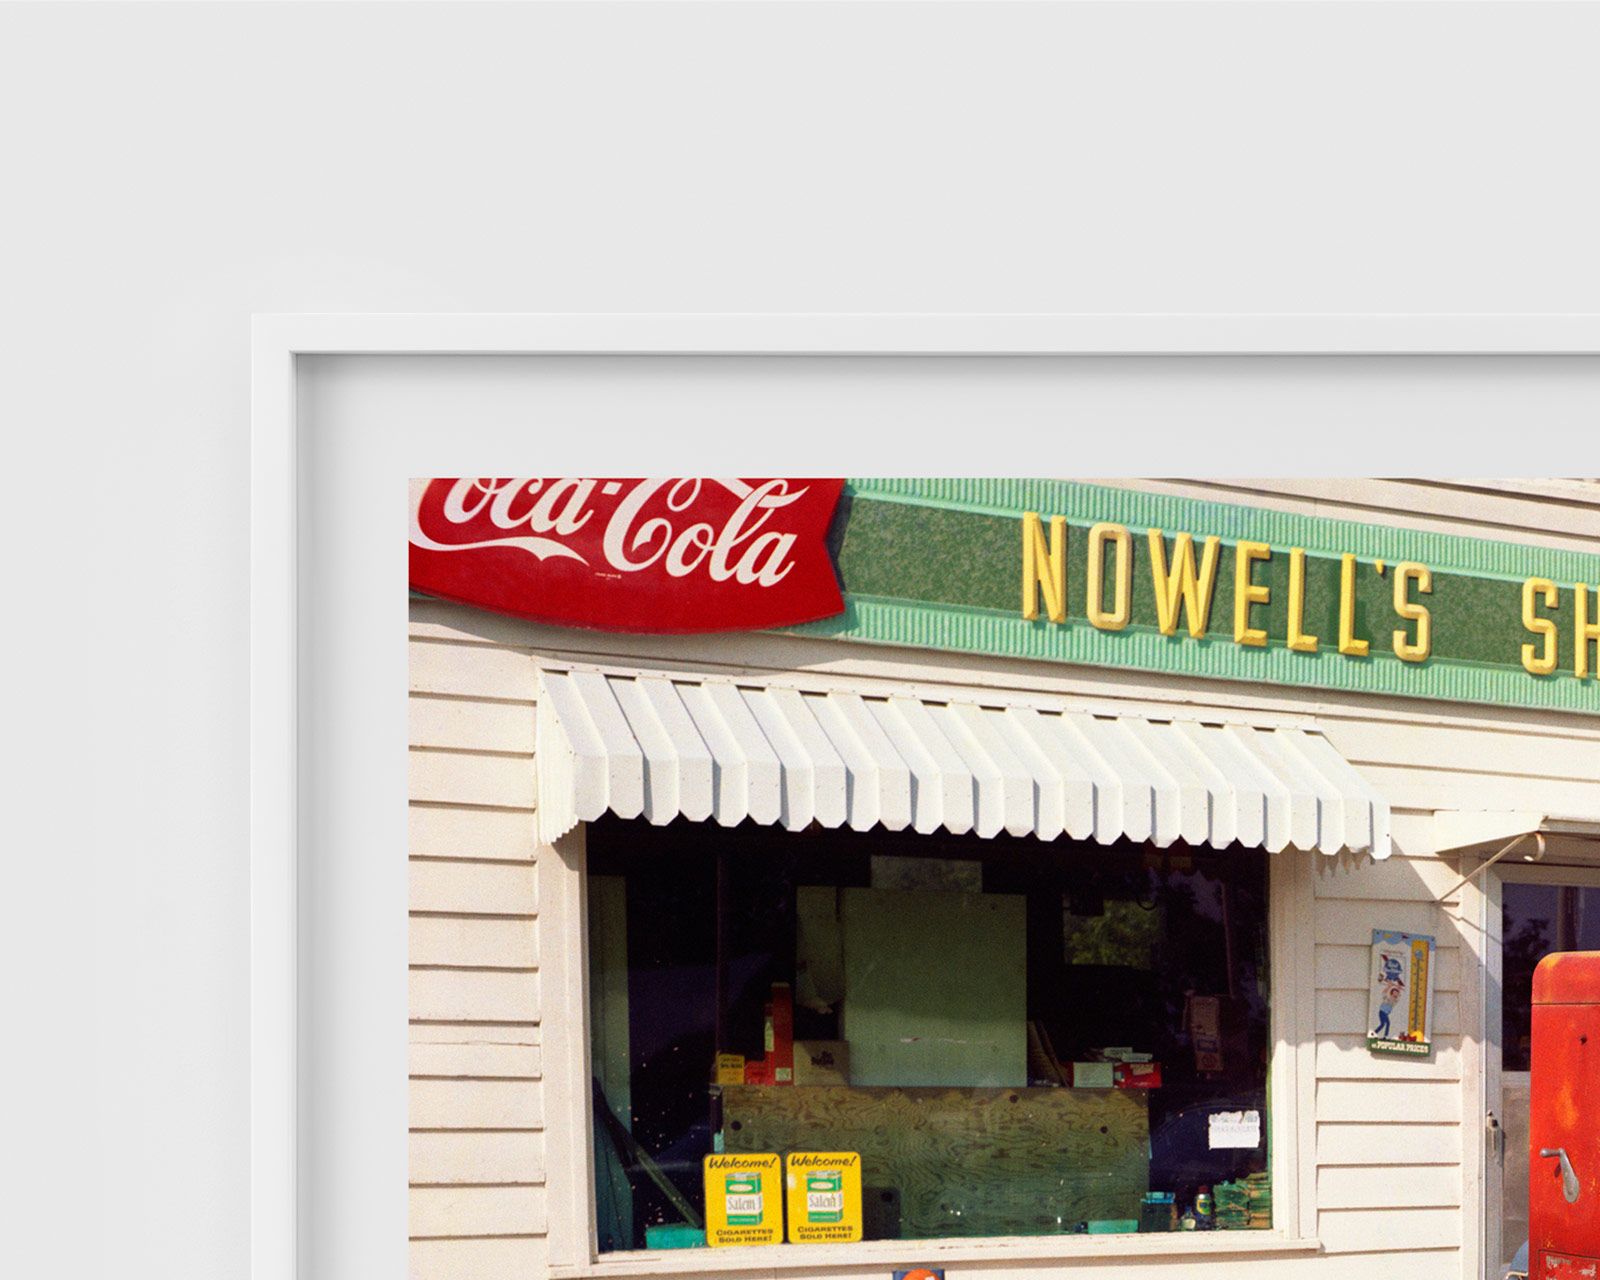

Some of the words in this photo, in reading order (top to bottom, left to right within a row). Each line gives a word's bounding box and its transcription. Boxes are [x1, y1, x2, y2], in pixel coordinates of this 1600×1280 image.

[1022, 510, 1432, 663] NOWELL'S
[709, 1156, 777, 1168] Welcome!
[791, 1155, 857, 1167] Welcome!
